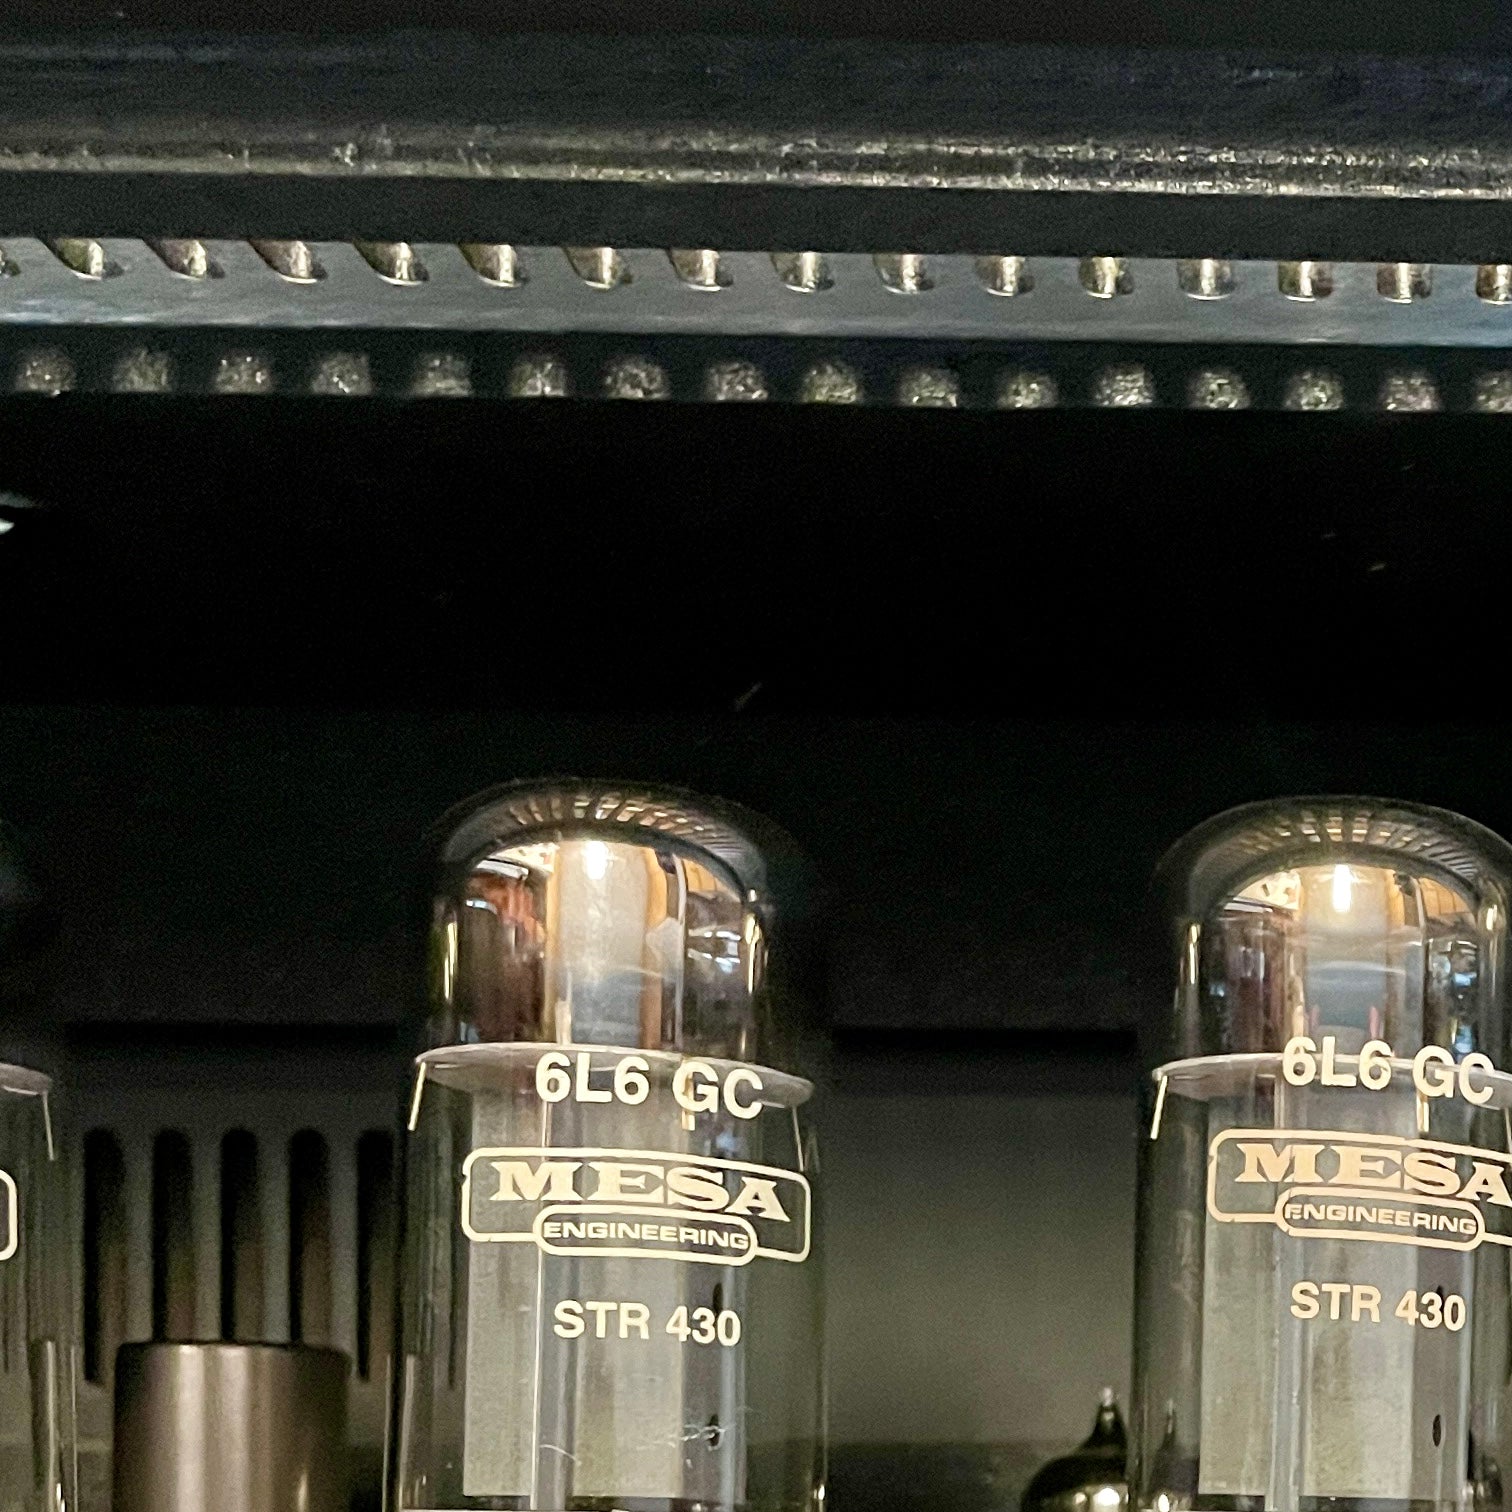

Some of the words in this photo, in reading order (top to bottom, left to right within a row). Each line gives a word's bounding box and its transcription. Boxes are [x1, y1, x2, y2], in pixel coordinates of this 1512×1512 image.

[536, 1053, 650, 1105] 6L6
[672, 1060, 764, 1120] GC
[1282, 1036, 1393, 1091] 6L6
[1413, 1046, 1495, 1103] GC
[489, 1160, 791, 1222] MESA
[543, 1221, 750, 1252] ENGINEERING
[1284, 1202, 1477, 1235] ENGINEERING
[553, 1301, 650, 1341] STR
[665, 1306, 741, 1347] 430
[1290, 1282, 1380, 1322] STR
[1395, 1290, 1466, 1331] 430
